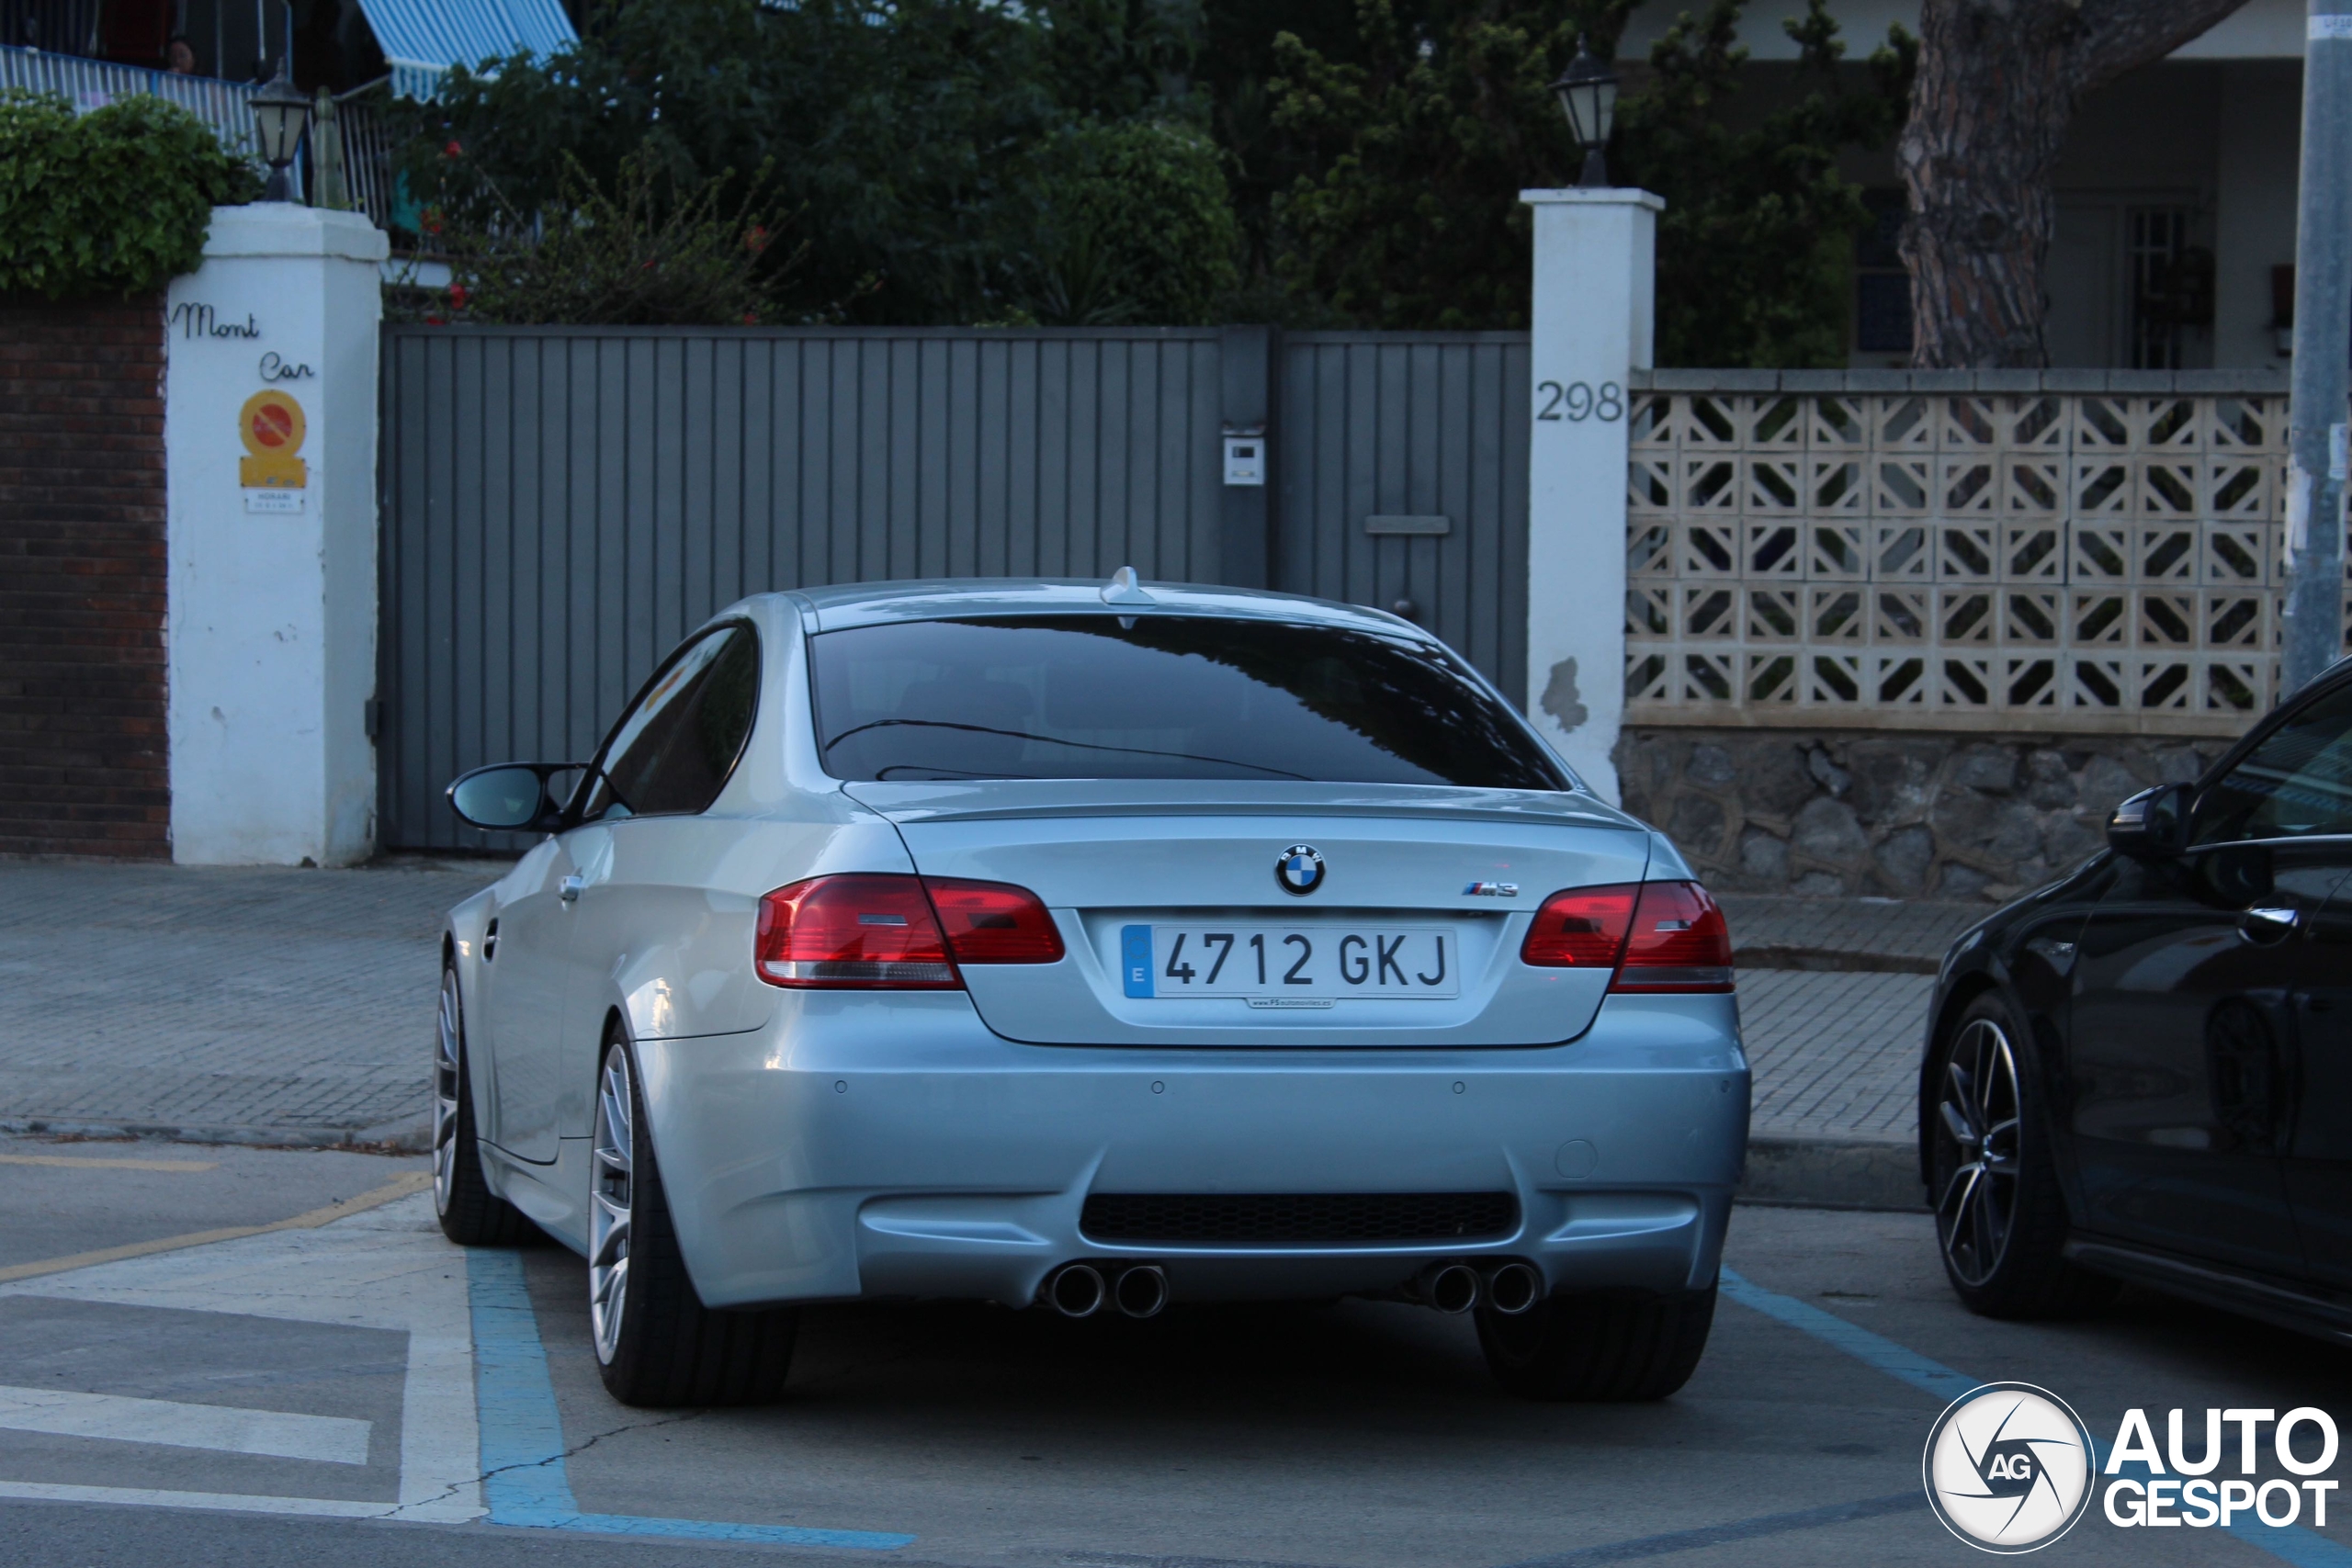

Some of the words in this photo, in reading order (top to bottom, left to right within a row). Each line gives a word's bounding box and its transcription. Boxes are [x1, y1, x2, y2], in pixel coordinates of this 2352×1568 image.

[172, 302, 260, 339] Mont
[259, 351, 315, 382] Car
[1536, 380, 1623, 422] 298
[1281, 846, 1322, 863] BMW
[1472, 882, 1519, 897] M3
[1132, 968, 1145, 982] E
[1166, 933, 1313, 985] 4712
[1339, 934, 1446, 986] GKJ
